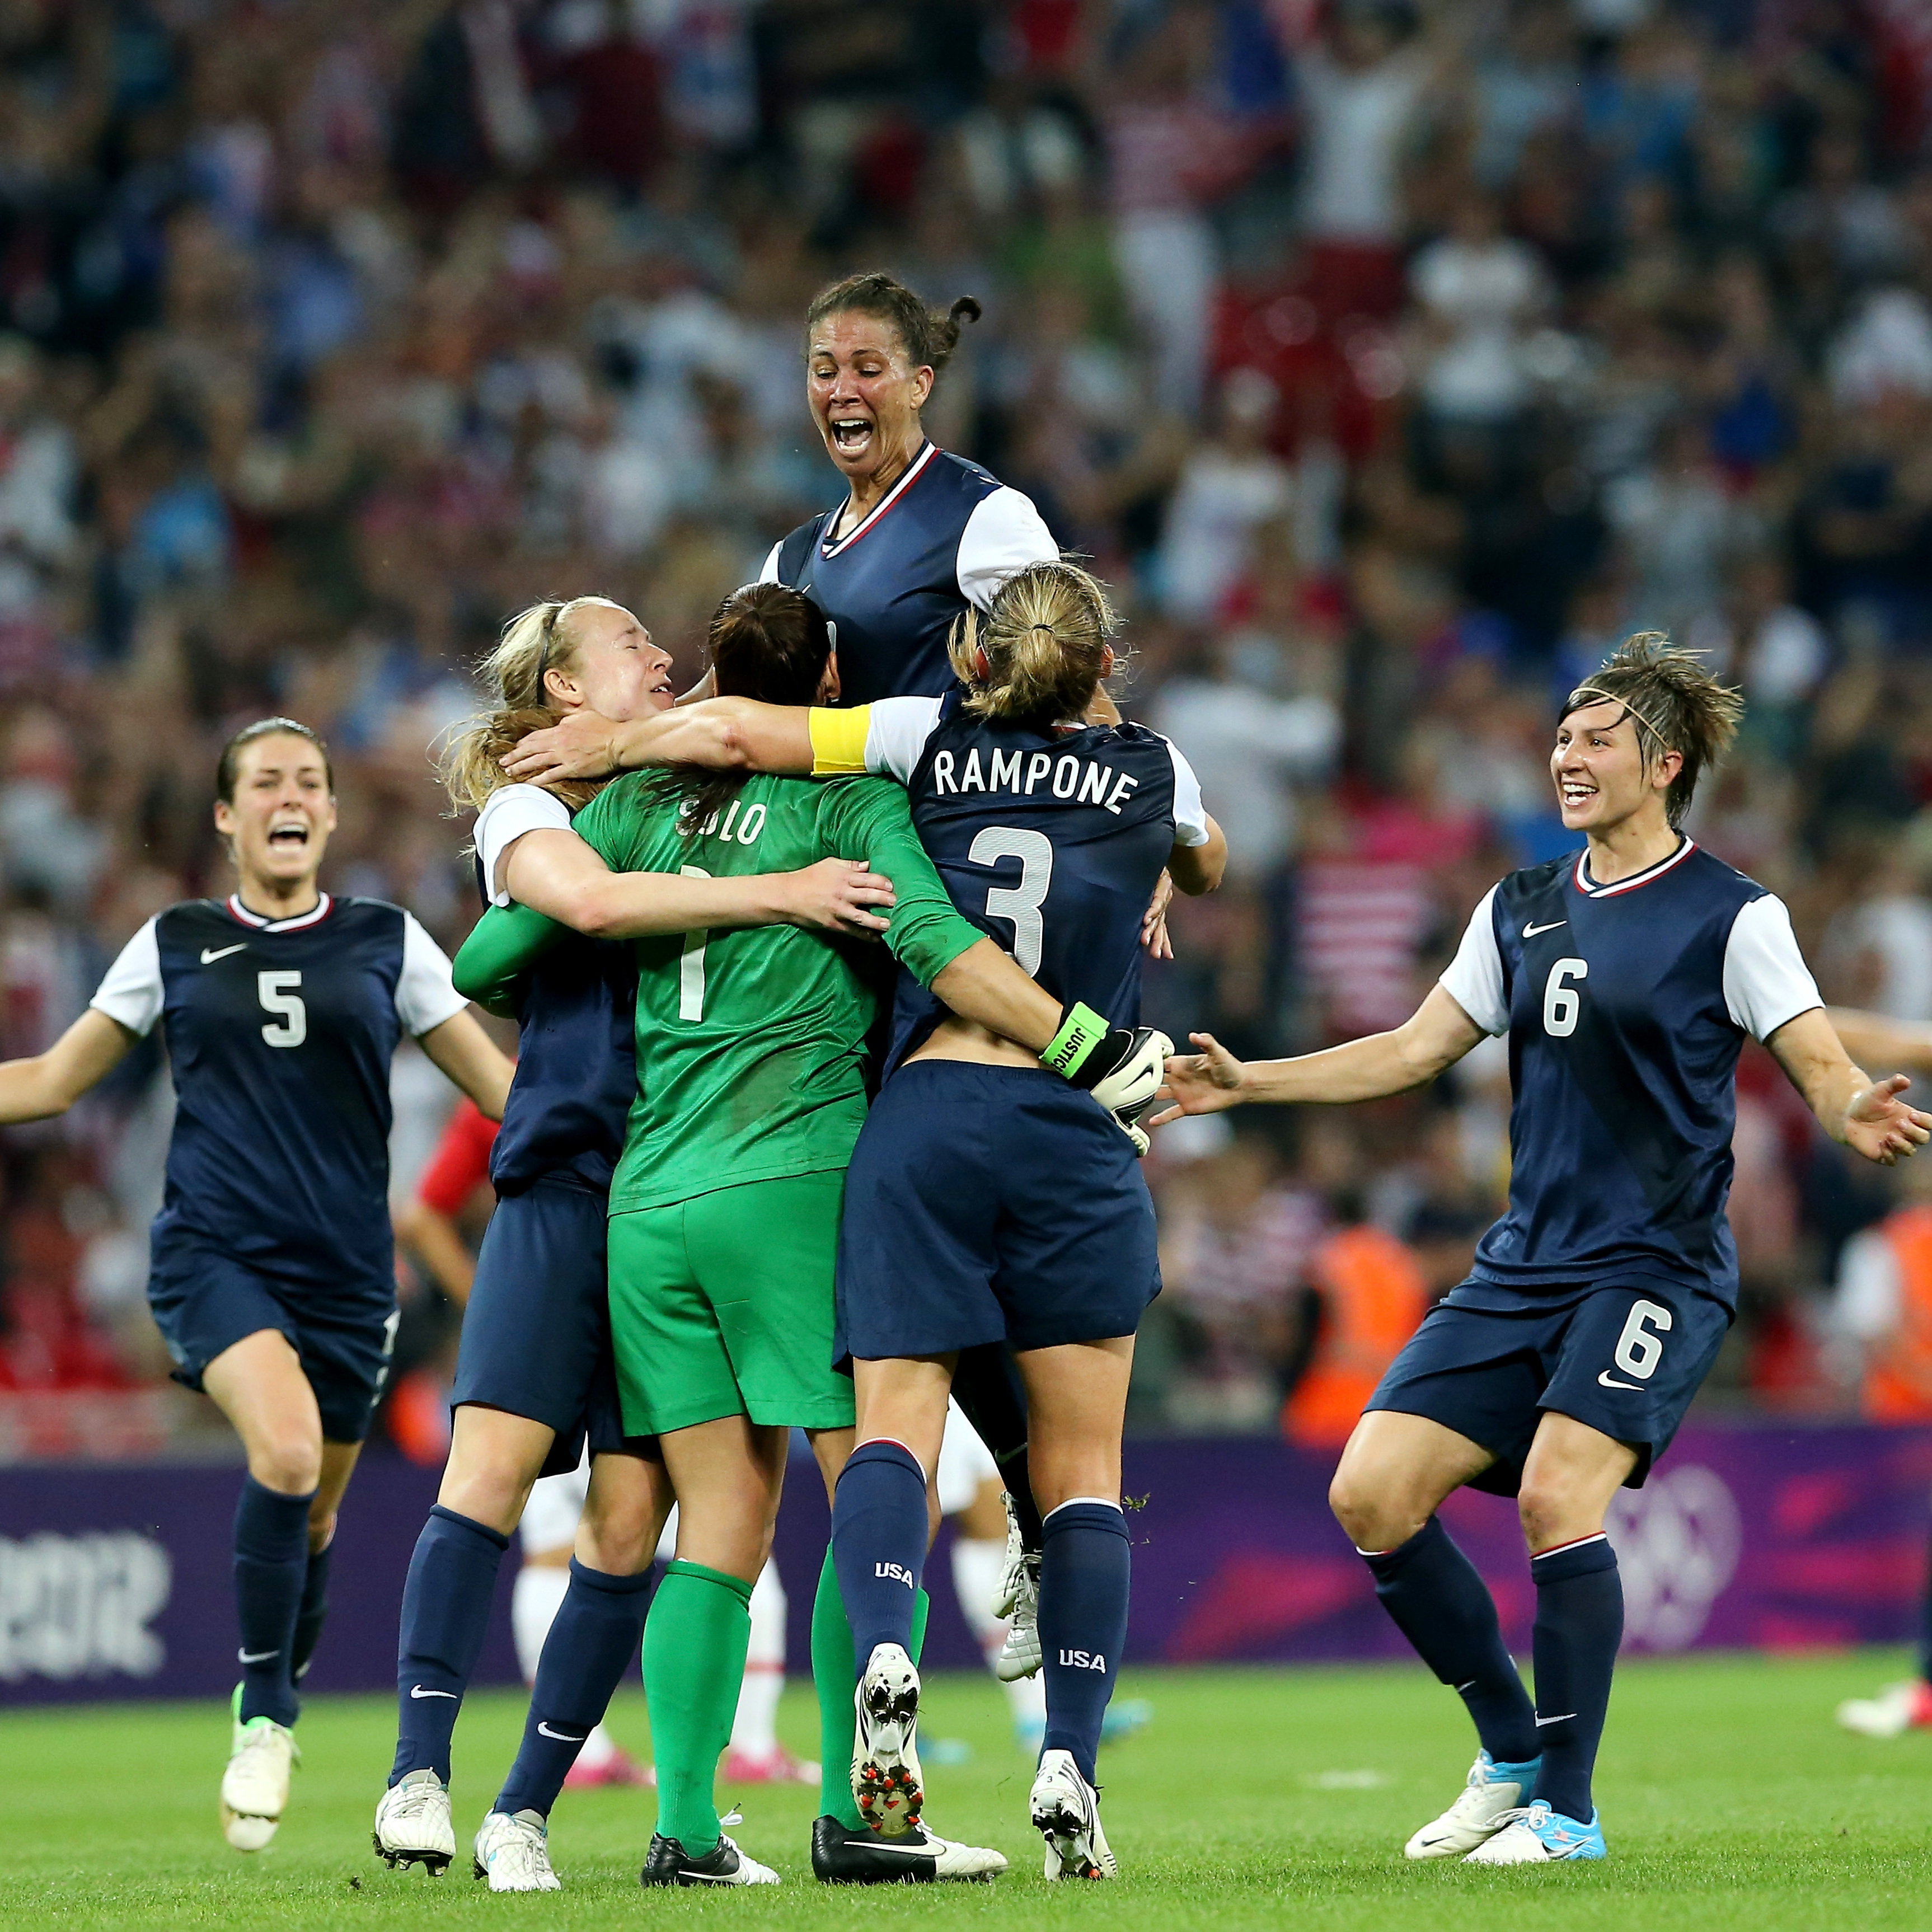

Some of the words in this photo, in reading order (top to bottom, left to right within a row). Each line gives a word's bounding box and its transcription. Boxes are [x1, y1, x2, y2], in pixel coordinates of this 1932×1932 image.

[934, 747, 1139, 815] RAMPONE
[968, 826, 1054, 978] 3
[257, 970, 307, 1048] 5
[1543, 957, 1588, 1037] 6
[1614, 1299, 1672, 1380] 6
[874, 1561, 913, 1589] USA
[1059, 1649, 1106, 1674] USA
